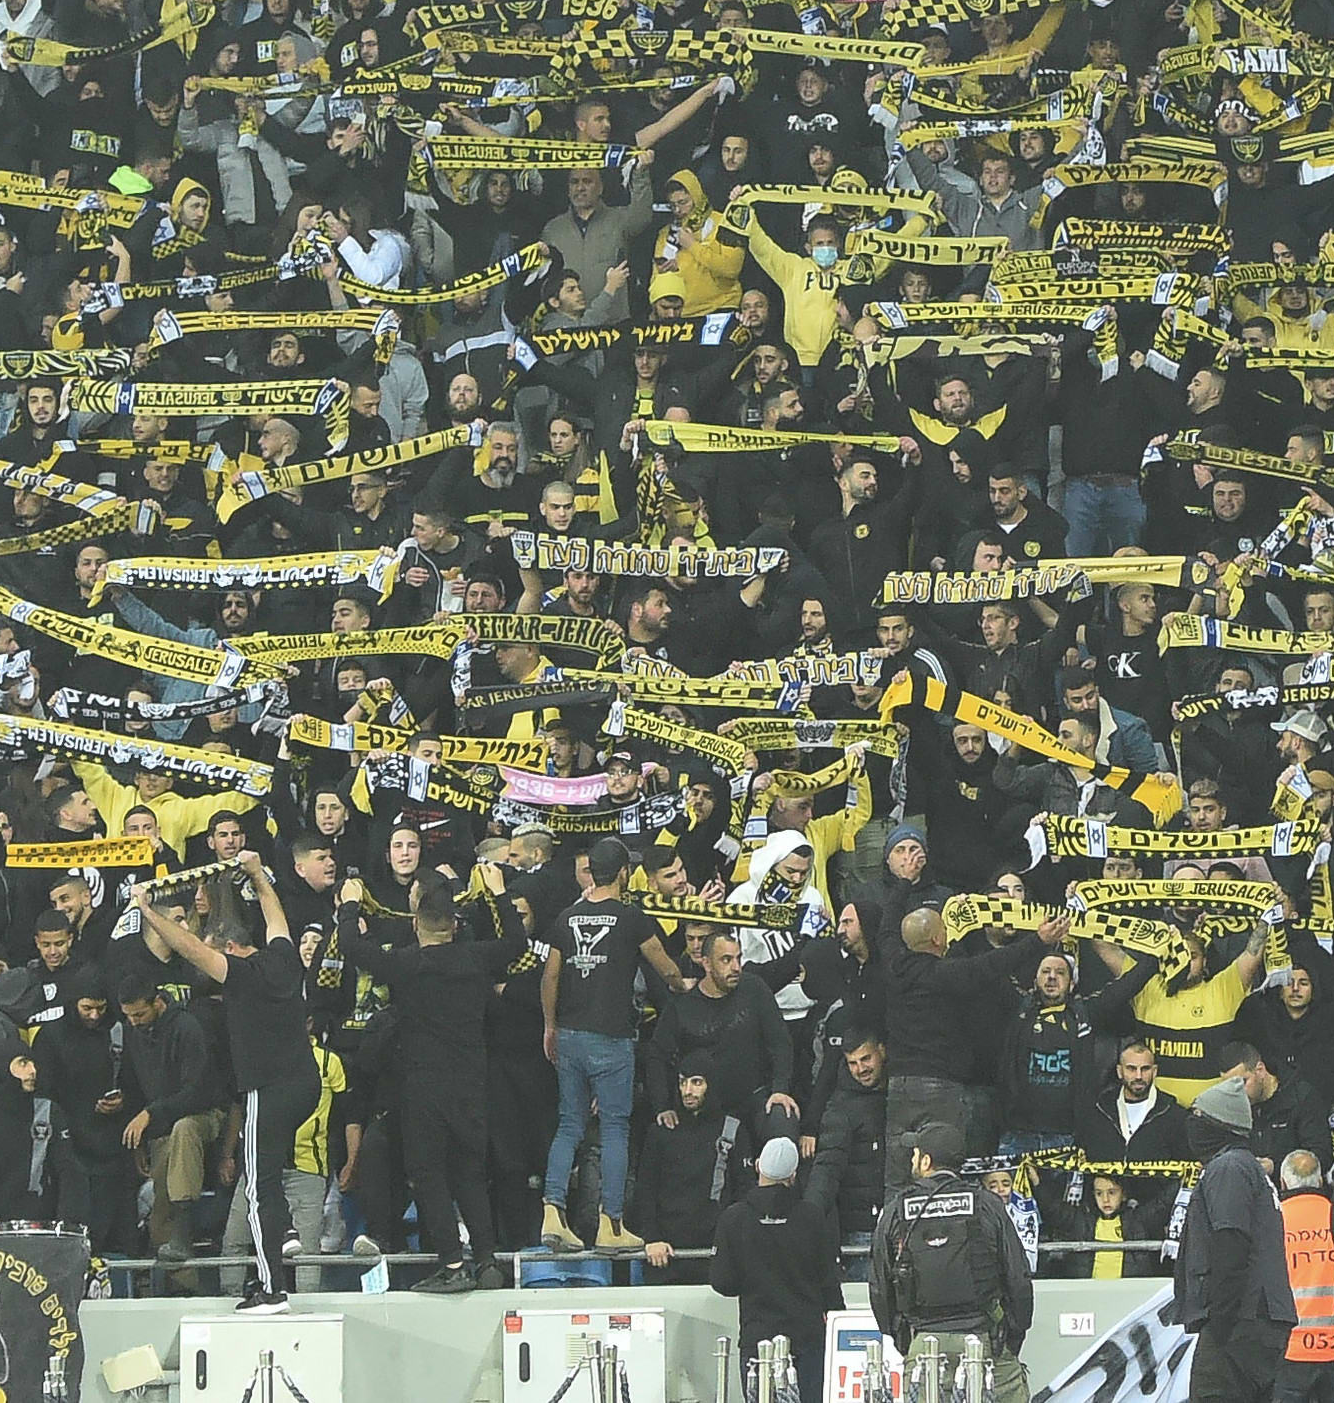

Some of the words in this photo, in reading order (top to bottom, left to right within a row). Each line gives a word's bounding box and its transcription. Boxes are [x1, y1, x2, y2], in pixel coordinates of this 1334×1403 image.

[419, 4, 485, 28] FCBJ
[1230, 50, 1288, 73] FAMI
[345, 80, 397, 95] משוגעים
[1065, 162, 1145, 184] ירושלים
[1019, 280, 1134, 295] ירושלים
[905, 305, 978, 316] ירושלים
[1008, 304, 1090, 317] JERUSALEM
[533, 328, 620, 353] ירושלים
[301, 432, 433, 481] ירושלים
[29, 609, 96, 635] ירושלים
[145, 645, 221, 674] JERUSALEM
[578, 680, 598, 693] FC
[427, 784, 490, 813] ירושלים
[1128, 830, 1249, 847] ירושלים
[1082, 883, 1153, 901] ירושלים
[1190, 884, 1276, 904] JERUSALEM
[1071, 1318, 1092, 1331] 3/1
